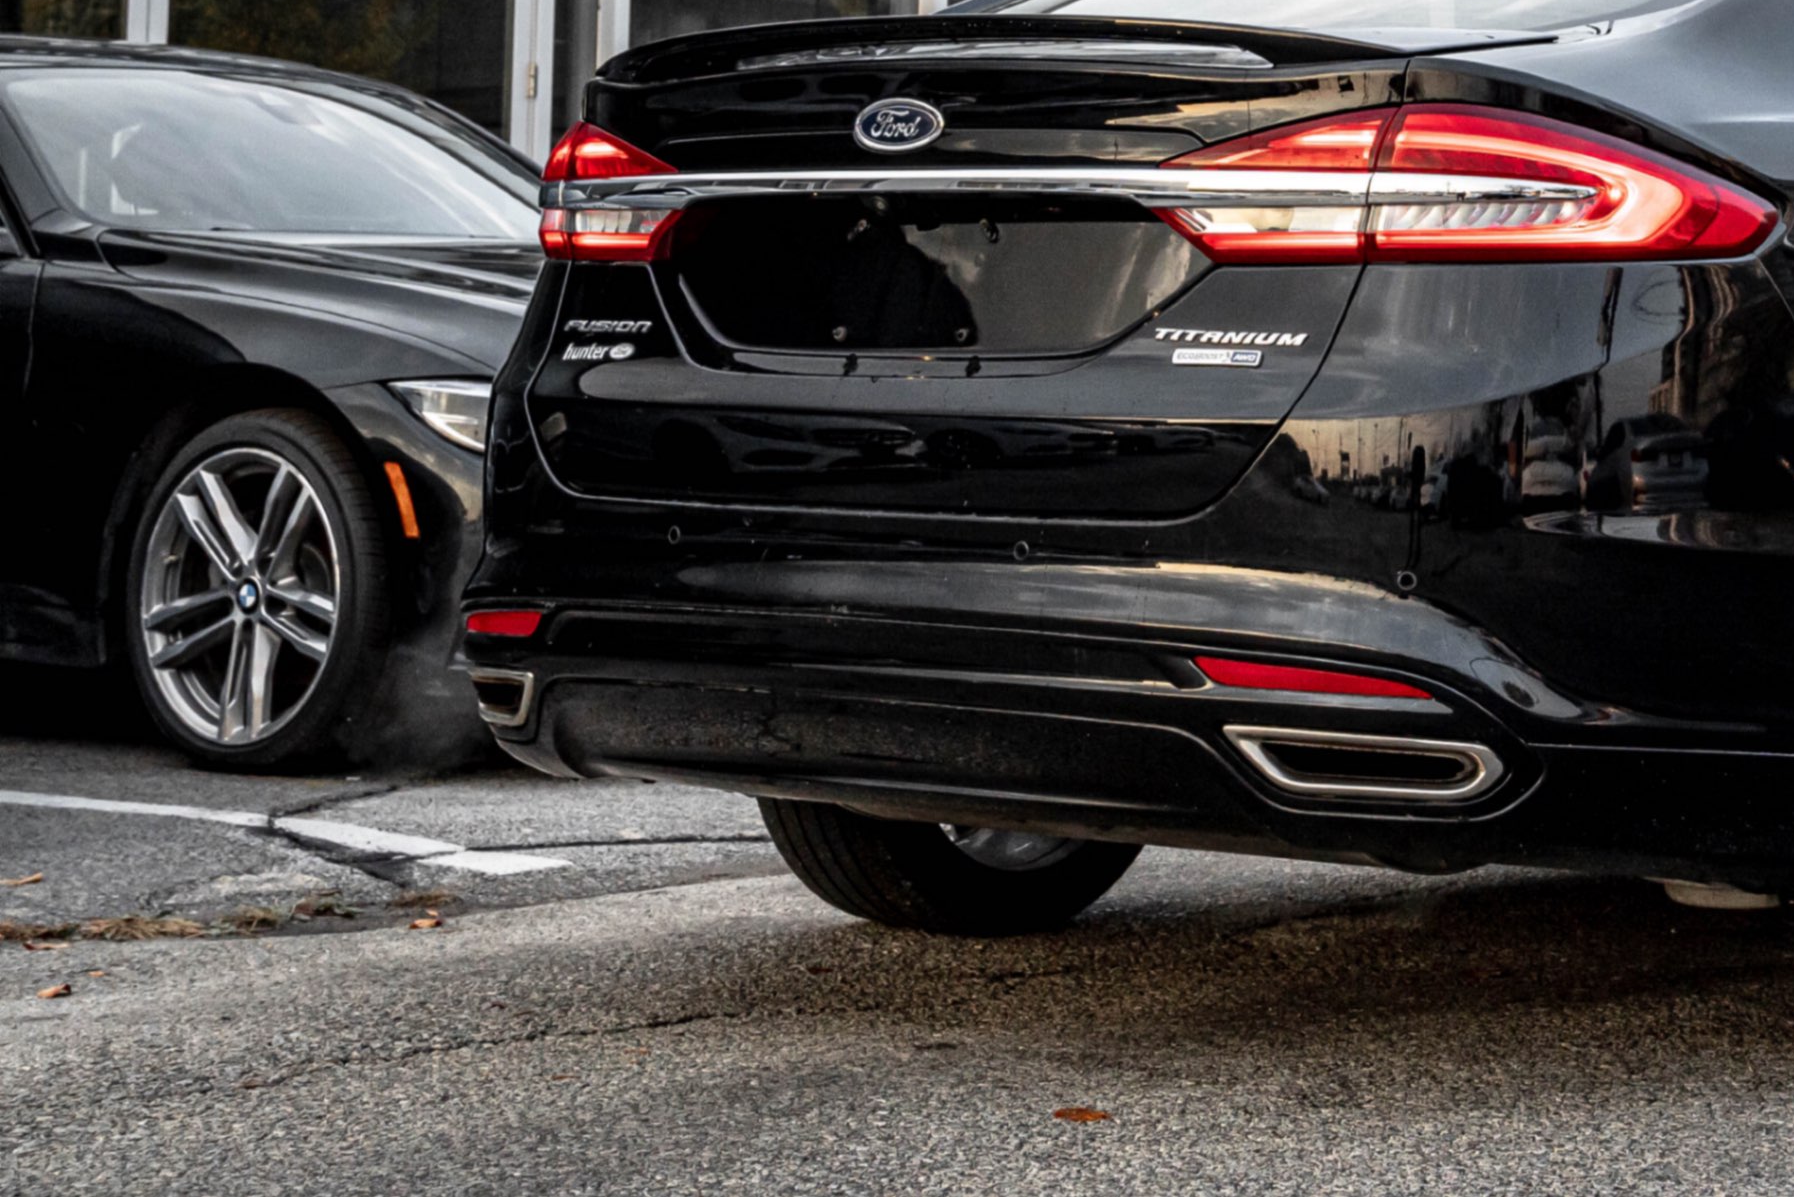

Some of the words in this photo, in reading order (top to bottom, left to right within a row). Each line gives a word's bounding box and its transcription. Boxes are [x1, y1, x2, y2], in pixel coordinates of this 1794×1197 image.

[870, 109, 922, 139] Ford
[563, 319, 653, 333] FUSION
[1154, 327, 1308, 346] TITANIUM
[561, 341, 610, 361] hunter
